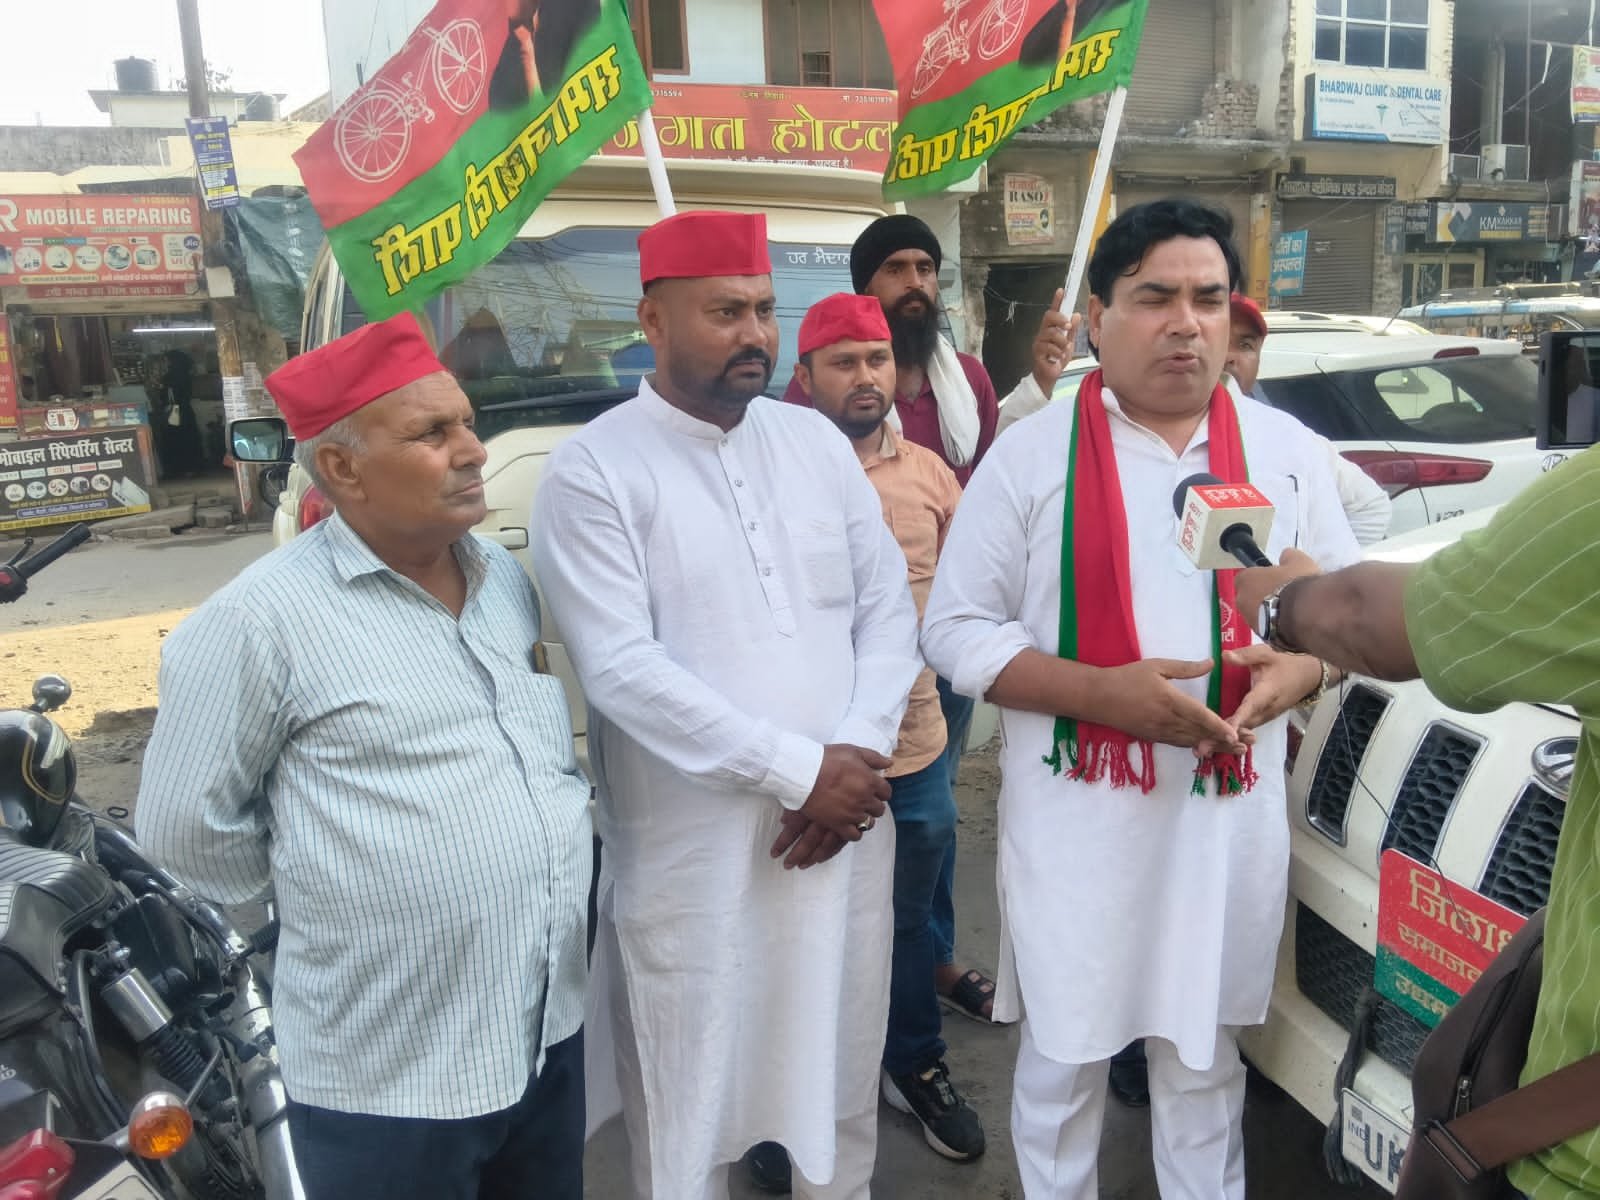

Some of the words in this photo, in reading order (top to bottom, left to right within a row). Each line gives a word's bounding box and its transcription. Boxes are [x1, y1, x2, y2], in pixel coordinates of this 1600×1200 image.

[1319, 79, 1363, 95] BHARDWAJ
[1364, 83, 1388, 98] CLINIC
[1397, 86, 1423, 101] DENTAL
[1424, 88, 1442, 102] CARE
[768, 103, 898, 154] होटल
[25, 208, 97, 226] MOBILE
[102, 207, 193, 226] REPARING
[0, 448, 46, 467] मोबाइल
[102, 436, 135, 455] सेन्टर
